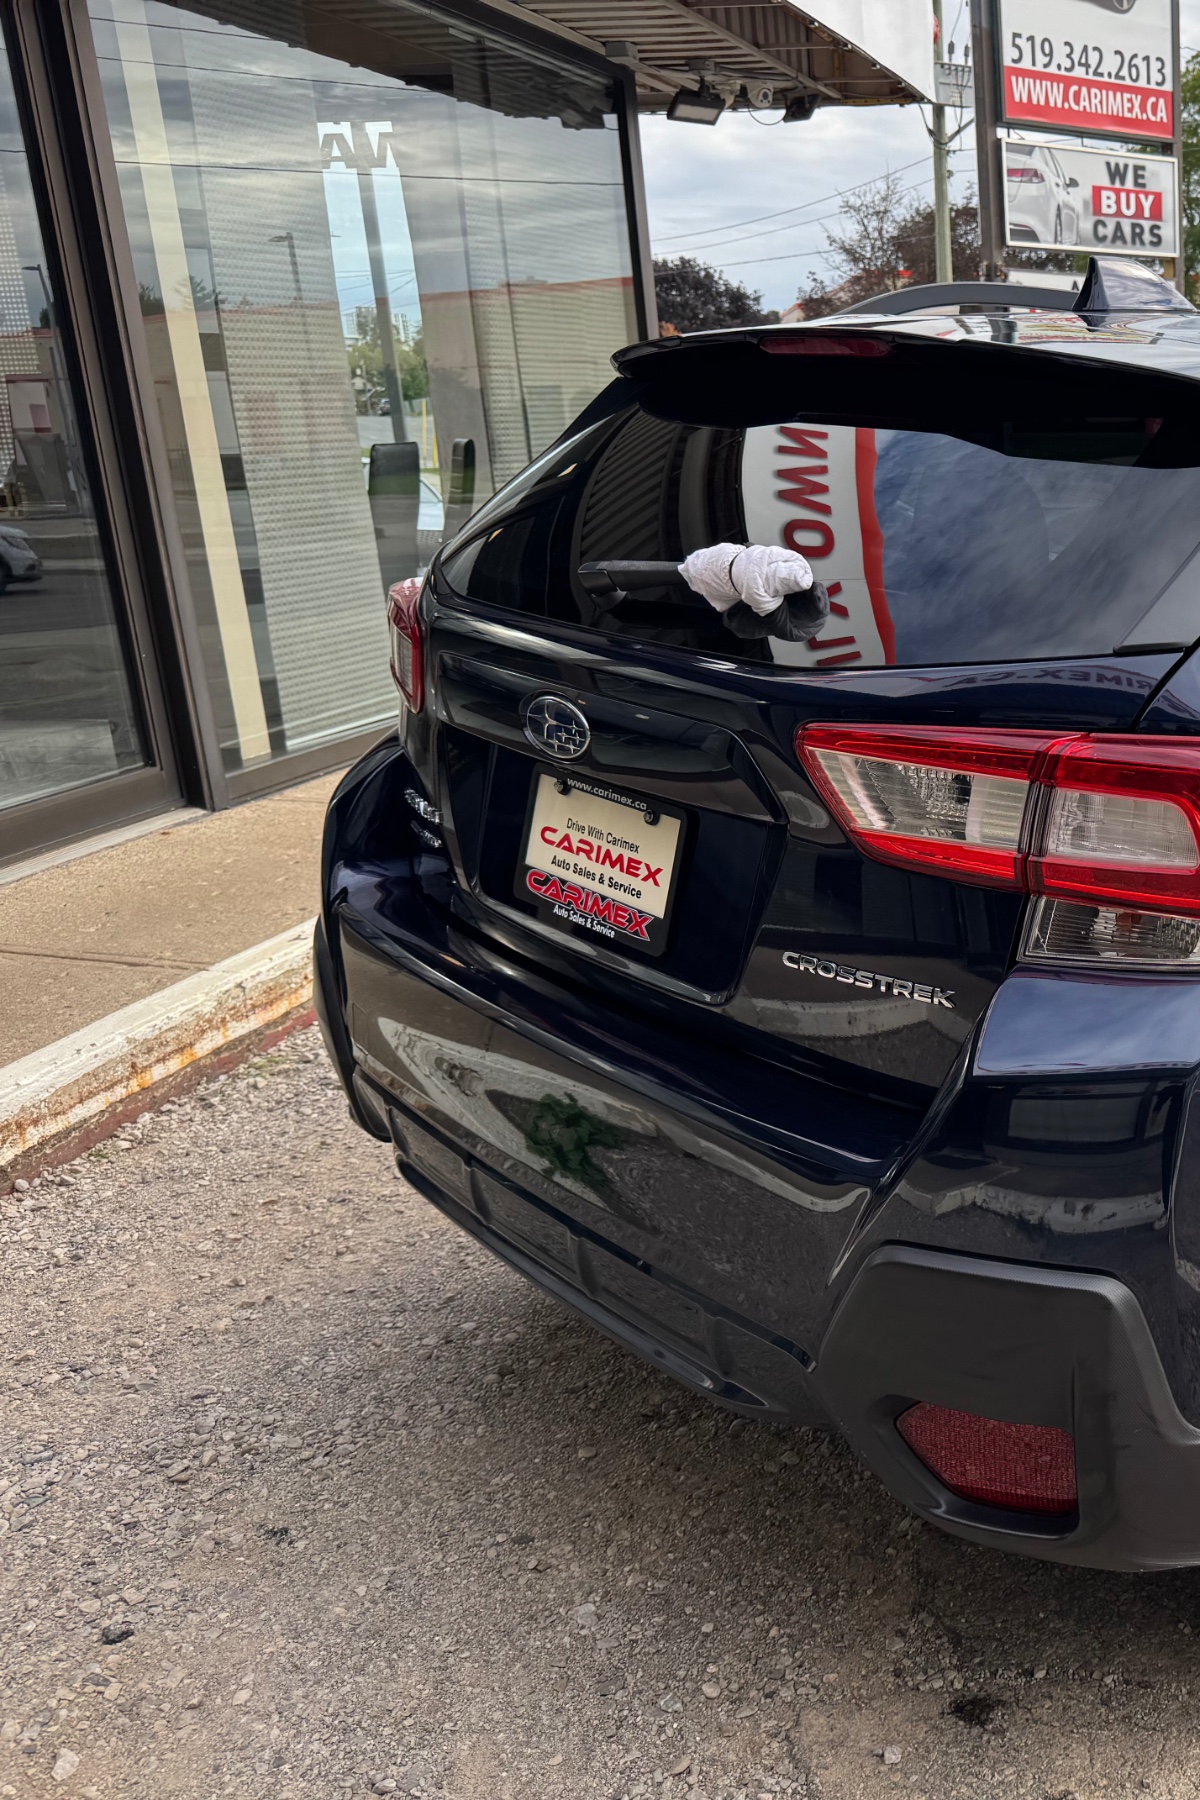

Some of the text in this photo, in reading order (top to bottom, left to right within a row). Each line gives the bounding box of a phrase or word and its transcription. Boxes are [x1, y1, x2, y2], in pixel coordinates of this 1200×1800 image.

[1011, 32, 1166, 87] 519.342.2613
[1010, 75, 1168, 123] WWW.CARIMEX.CA
[1105, 161, 1146, 189] WE
[1100, 189, 1155, 218] BUY
[1093, 219, 1163, 247] CARS
[567, 778, 647, 810] www.carimex.ca
[540, 825, 663, 887] CARIMEX
[566, 818, 640, 854] Drive With Carimex
[551, 855, 642, 899] Auto Sales & Service
[527, 869, 653, 941] CARIMEX
[553, 904, 616, 939] Auto Sales & Service
[782, 951, 955, 1009] CROSSTREK
